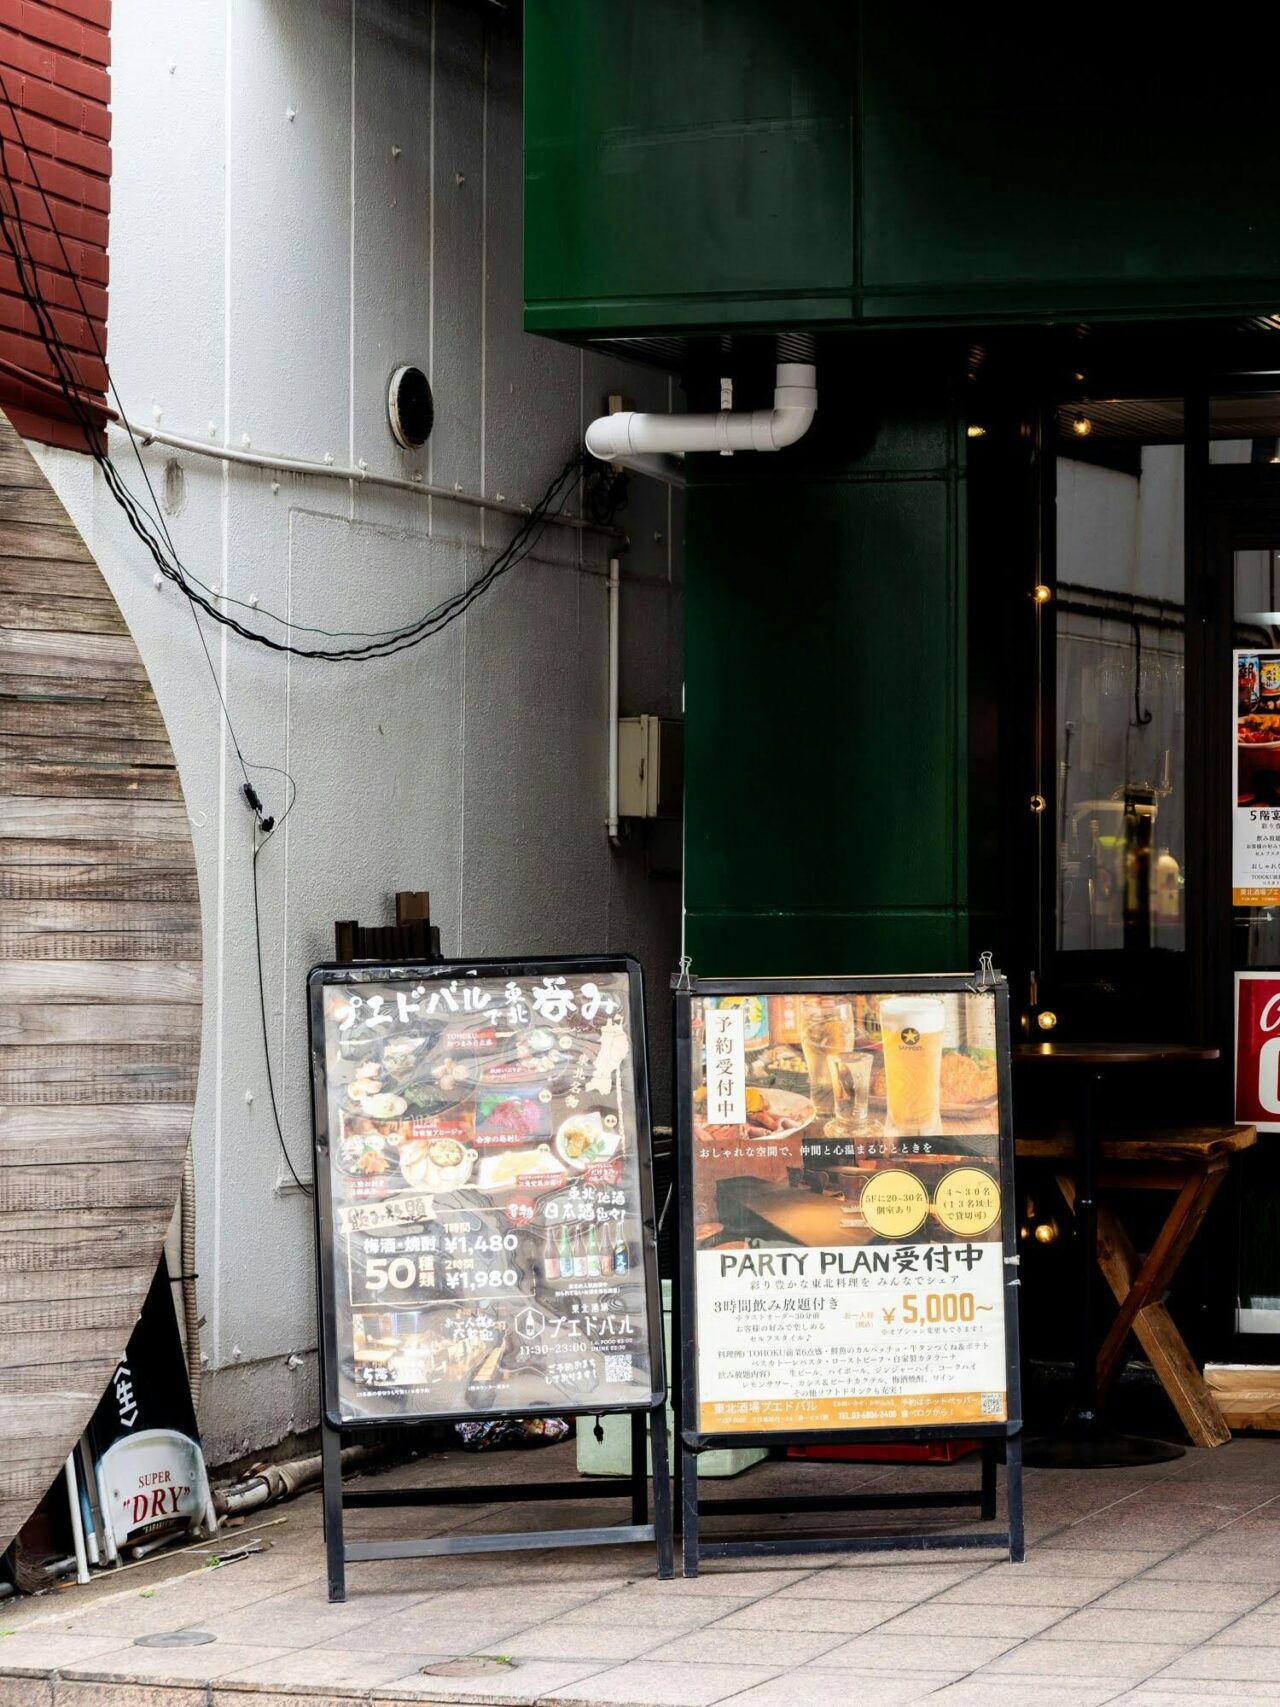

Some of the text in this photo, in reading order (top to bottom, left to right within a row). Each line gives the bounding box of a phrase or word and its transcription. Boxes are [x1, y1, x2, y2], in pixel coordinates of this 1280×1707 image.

[715, 1016, 734, 1118] 予約受付中
[699, 1142, 932, 1158] おしゃれな空間で、仲間と心温まるひとときを
[876, 1205, 912, 1215] 個室あり
[443, 1223, 471, 1233] 1時間
[444, 1234, 519, 1255] ¥1,480
[364, 1255, 435, 1290] 50 種類
[445, 1259, 474, 1270] 2時間
[720, 1253, 808, 1278] PARTY
[446, 1269, 518, 1291] ¥1,980
[750, 1275, 959, 1291] 彩り豊かな東北料理を みんなでシェア
[714, 1297, 838, 1313] 3時間飲み放題付き
[549, 1314, 634, 1338] プエドバル
[736, 1323, 826, 1333] お客様の好みで楽しめる
[714, 1401, 817, 1414] 東北酒場プエドバル
[138, 1470, 171, 1488] SUPER
